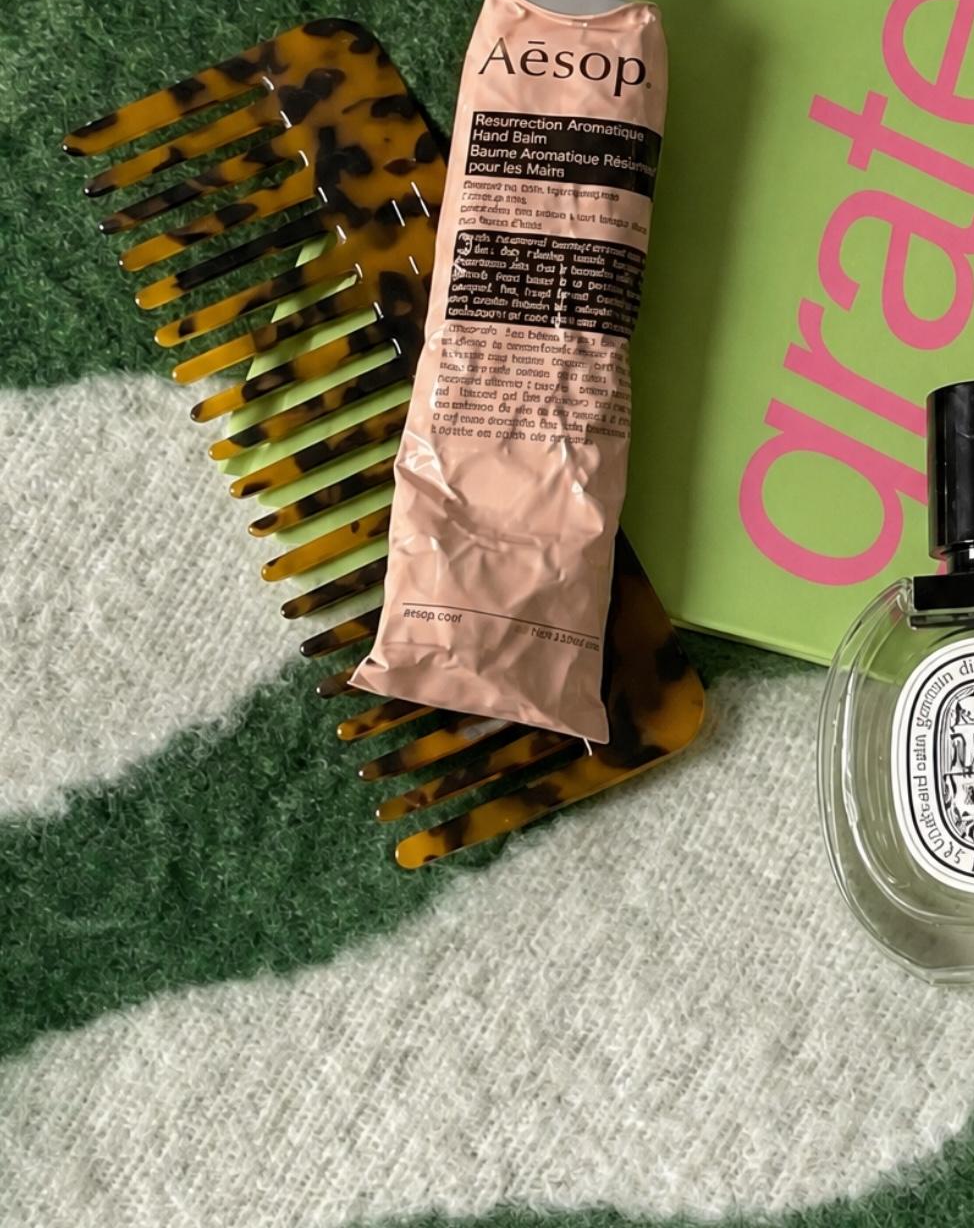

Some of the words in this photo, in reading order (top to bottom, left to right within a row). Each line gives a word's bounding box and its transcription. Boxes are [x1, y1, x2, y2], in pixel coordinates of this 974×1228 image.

[472, 129, 509, 143] Hand
[513, 131, 548, 145] Balm
[475, 114, 562, 131] Resurrection
[567, 119, 645, 143] Aromatique
[470, 145, 518, 159] Baume
[520, 147, 600, 167] Aromatique
[468, 160, 501, 175] pour
[503, 161, 523, 175] les
